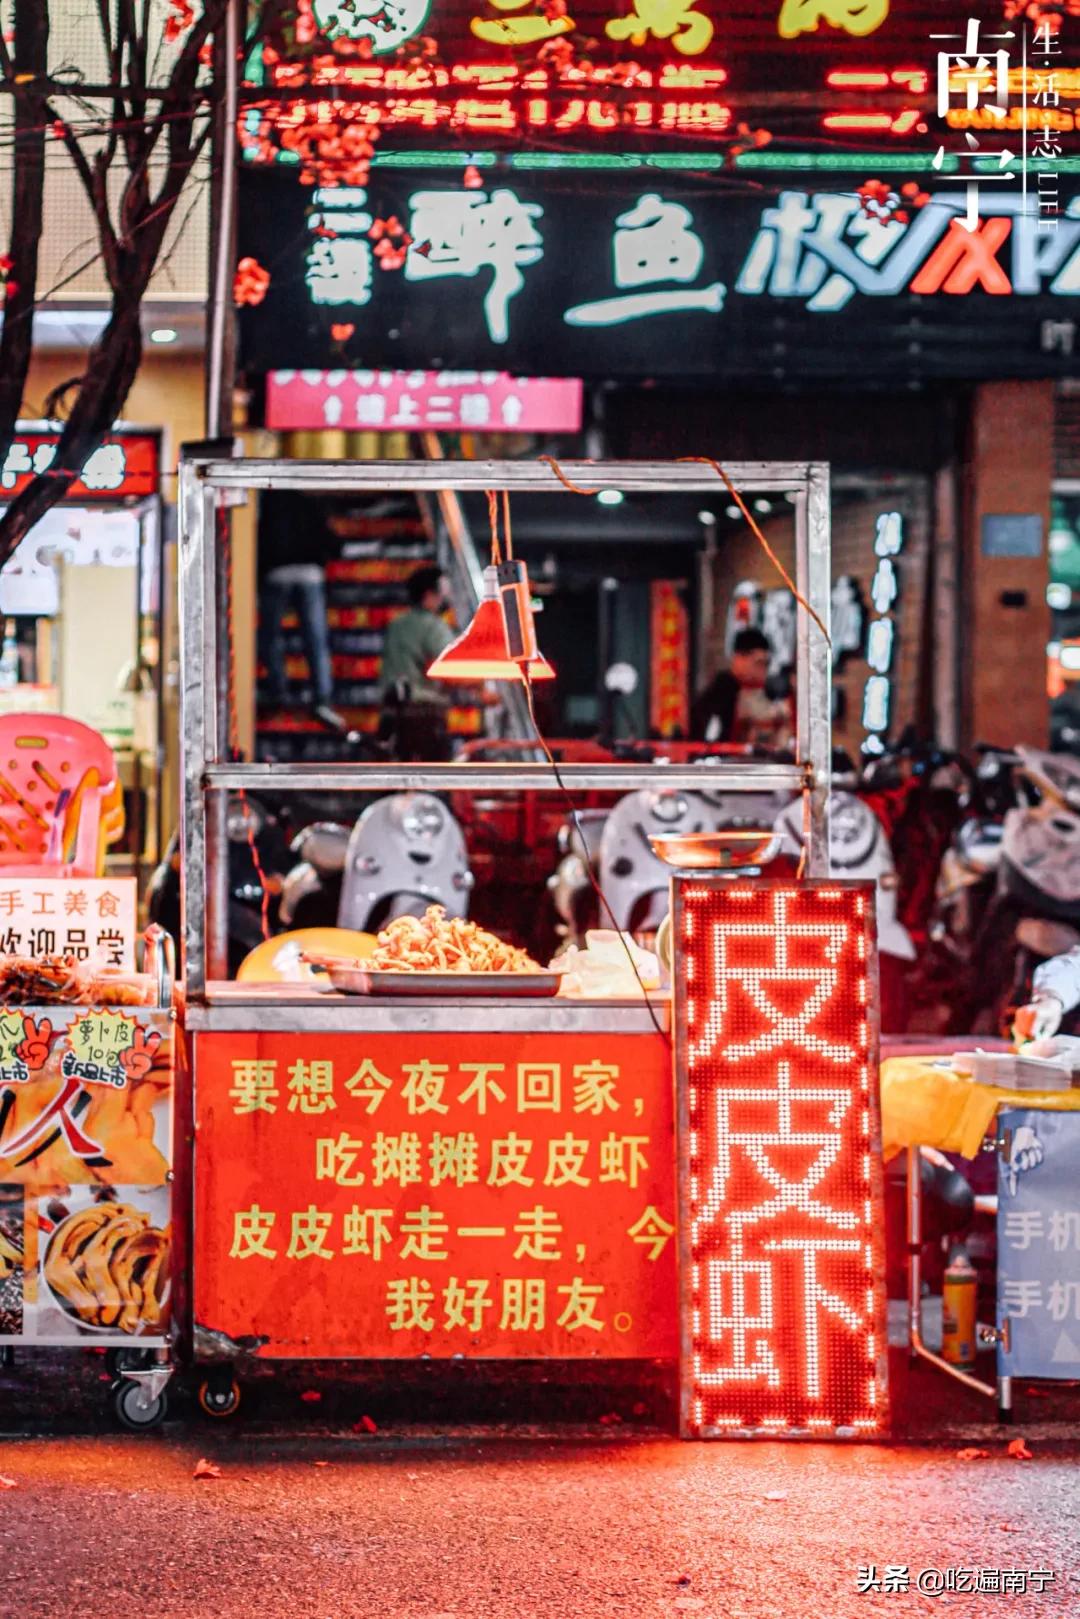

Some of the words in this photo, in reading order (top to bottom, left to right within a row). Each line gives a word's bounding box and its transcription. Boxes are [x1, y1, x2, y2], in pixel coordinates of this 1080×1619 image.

[0, 889, 120, 917] 手工美食
[0, 928, 125, 966] 欢迎品尝
[0, 1061, 28, 1081] 上市
[62, 1052, 126, 1087] 新品上市
[229, 1059, 644, 1116] 要想今夜不回家，
[315, 1132, 650, 1188] 吃摊摊皮皮虾
[690, 892, 860, 1400] 皮皮虾
[1004, 1211, 1080, 1251] 手机
[385, 1277, 632, 1333] 我好朋友。
[1004, 1280, 1080, 1321] 手机
